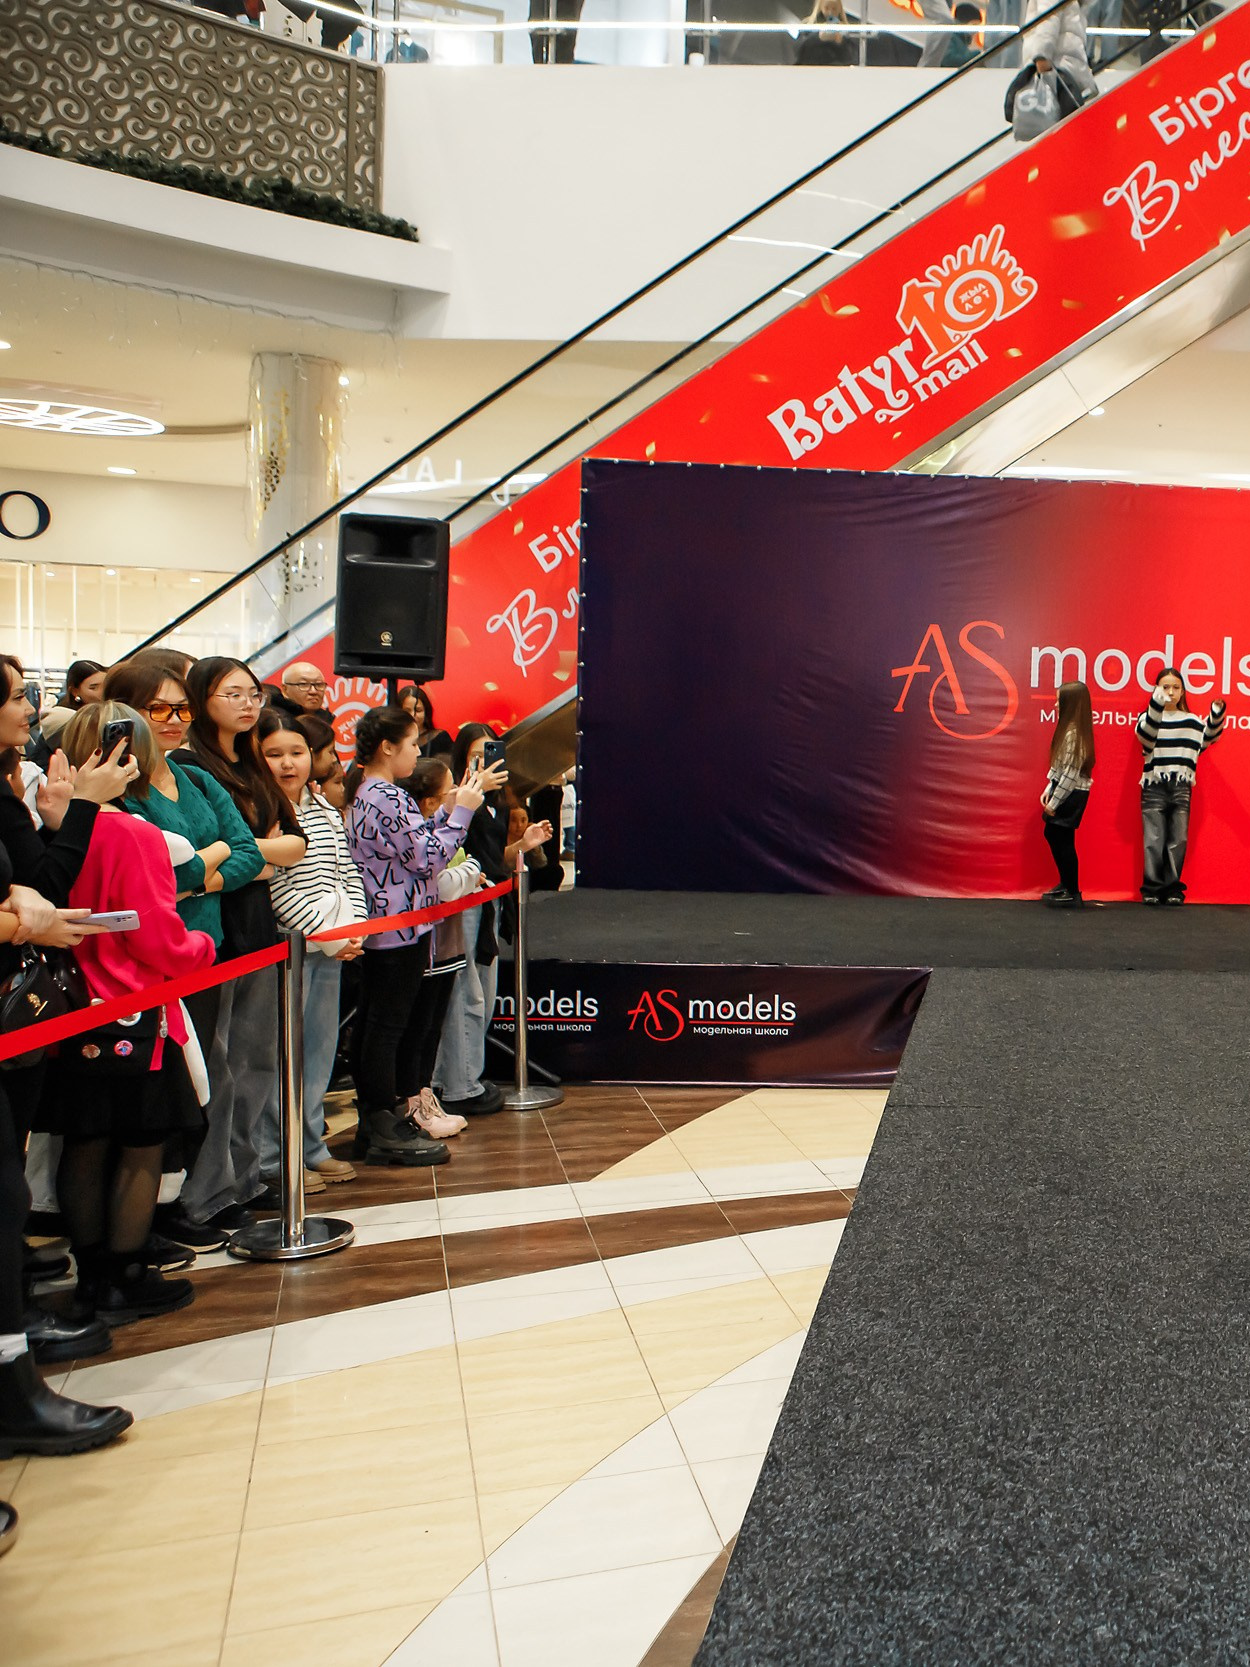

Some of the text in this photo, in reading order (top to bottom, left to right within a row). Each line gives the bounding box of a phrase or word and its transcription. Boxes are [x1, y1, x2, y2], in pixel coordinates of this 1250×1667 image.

[766, 338, 919, 460] Batyr
[912, 339, 988, 402] mall
[891, 620, 1019, 740] AS
[493, 1023, 592, 1032] модьная школа
[627, 989, 797, 1042] AS models
[693, 1026, 789, 1036] модельная школа
